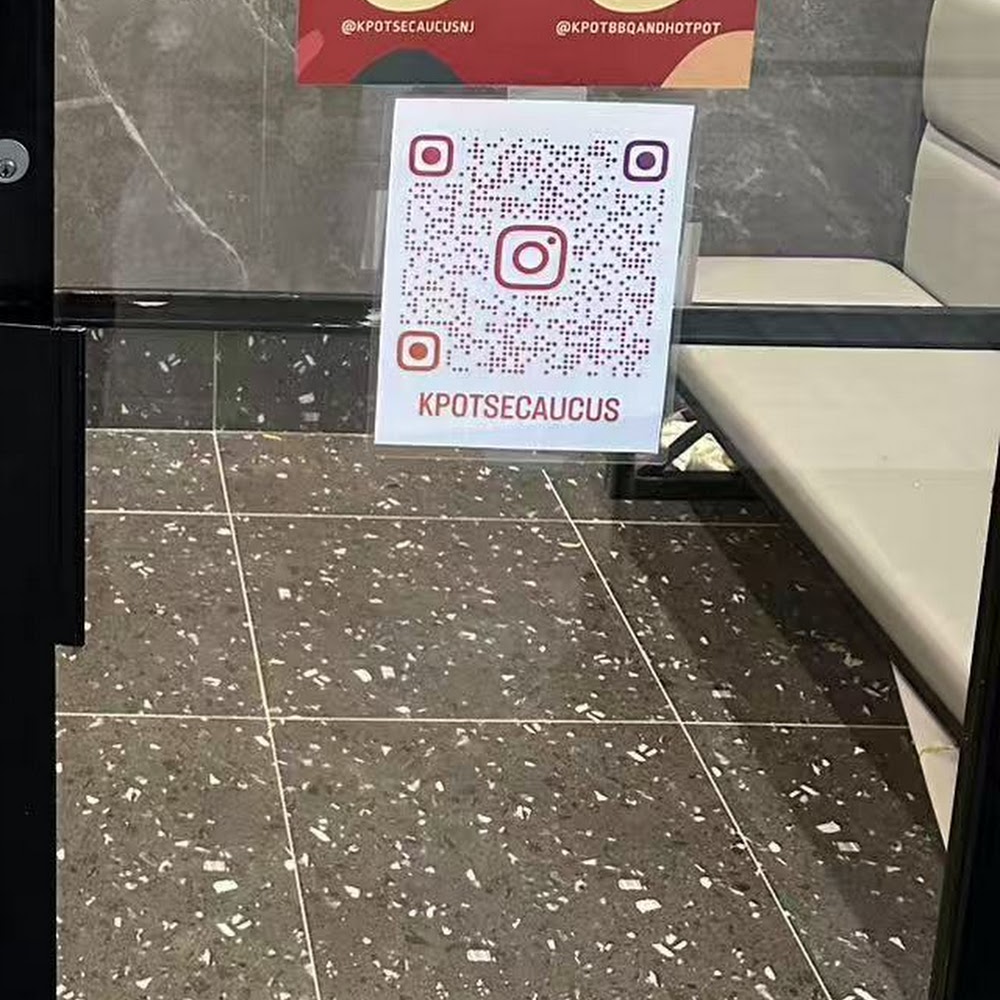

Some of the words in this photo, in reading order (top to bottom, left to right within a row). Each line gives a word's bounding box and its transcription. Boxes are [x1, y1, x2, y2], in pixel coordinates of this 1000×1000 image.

[341, 19, 475, 35] @KPOTSECAUCUSNJ
[555, 20, 722, 36] @KPOTBBQANDHOTPOT
[418, 392, 621, 422] KPOTSECAUCUS
